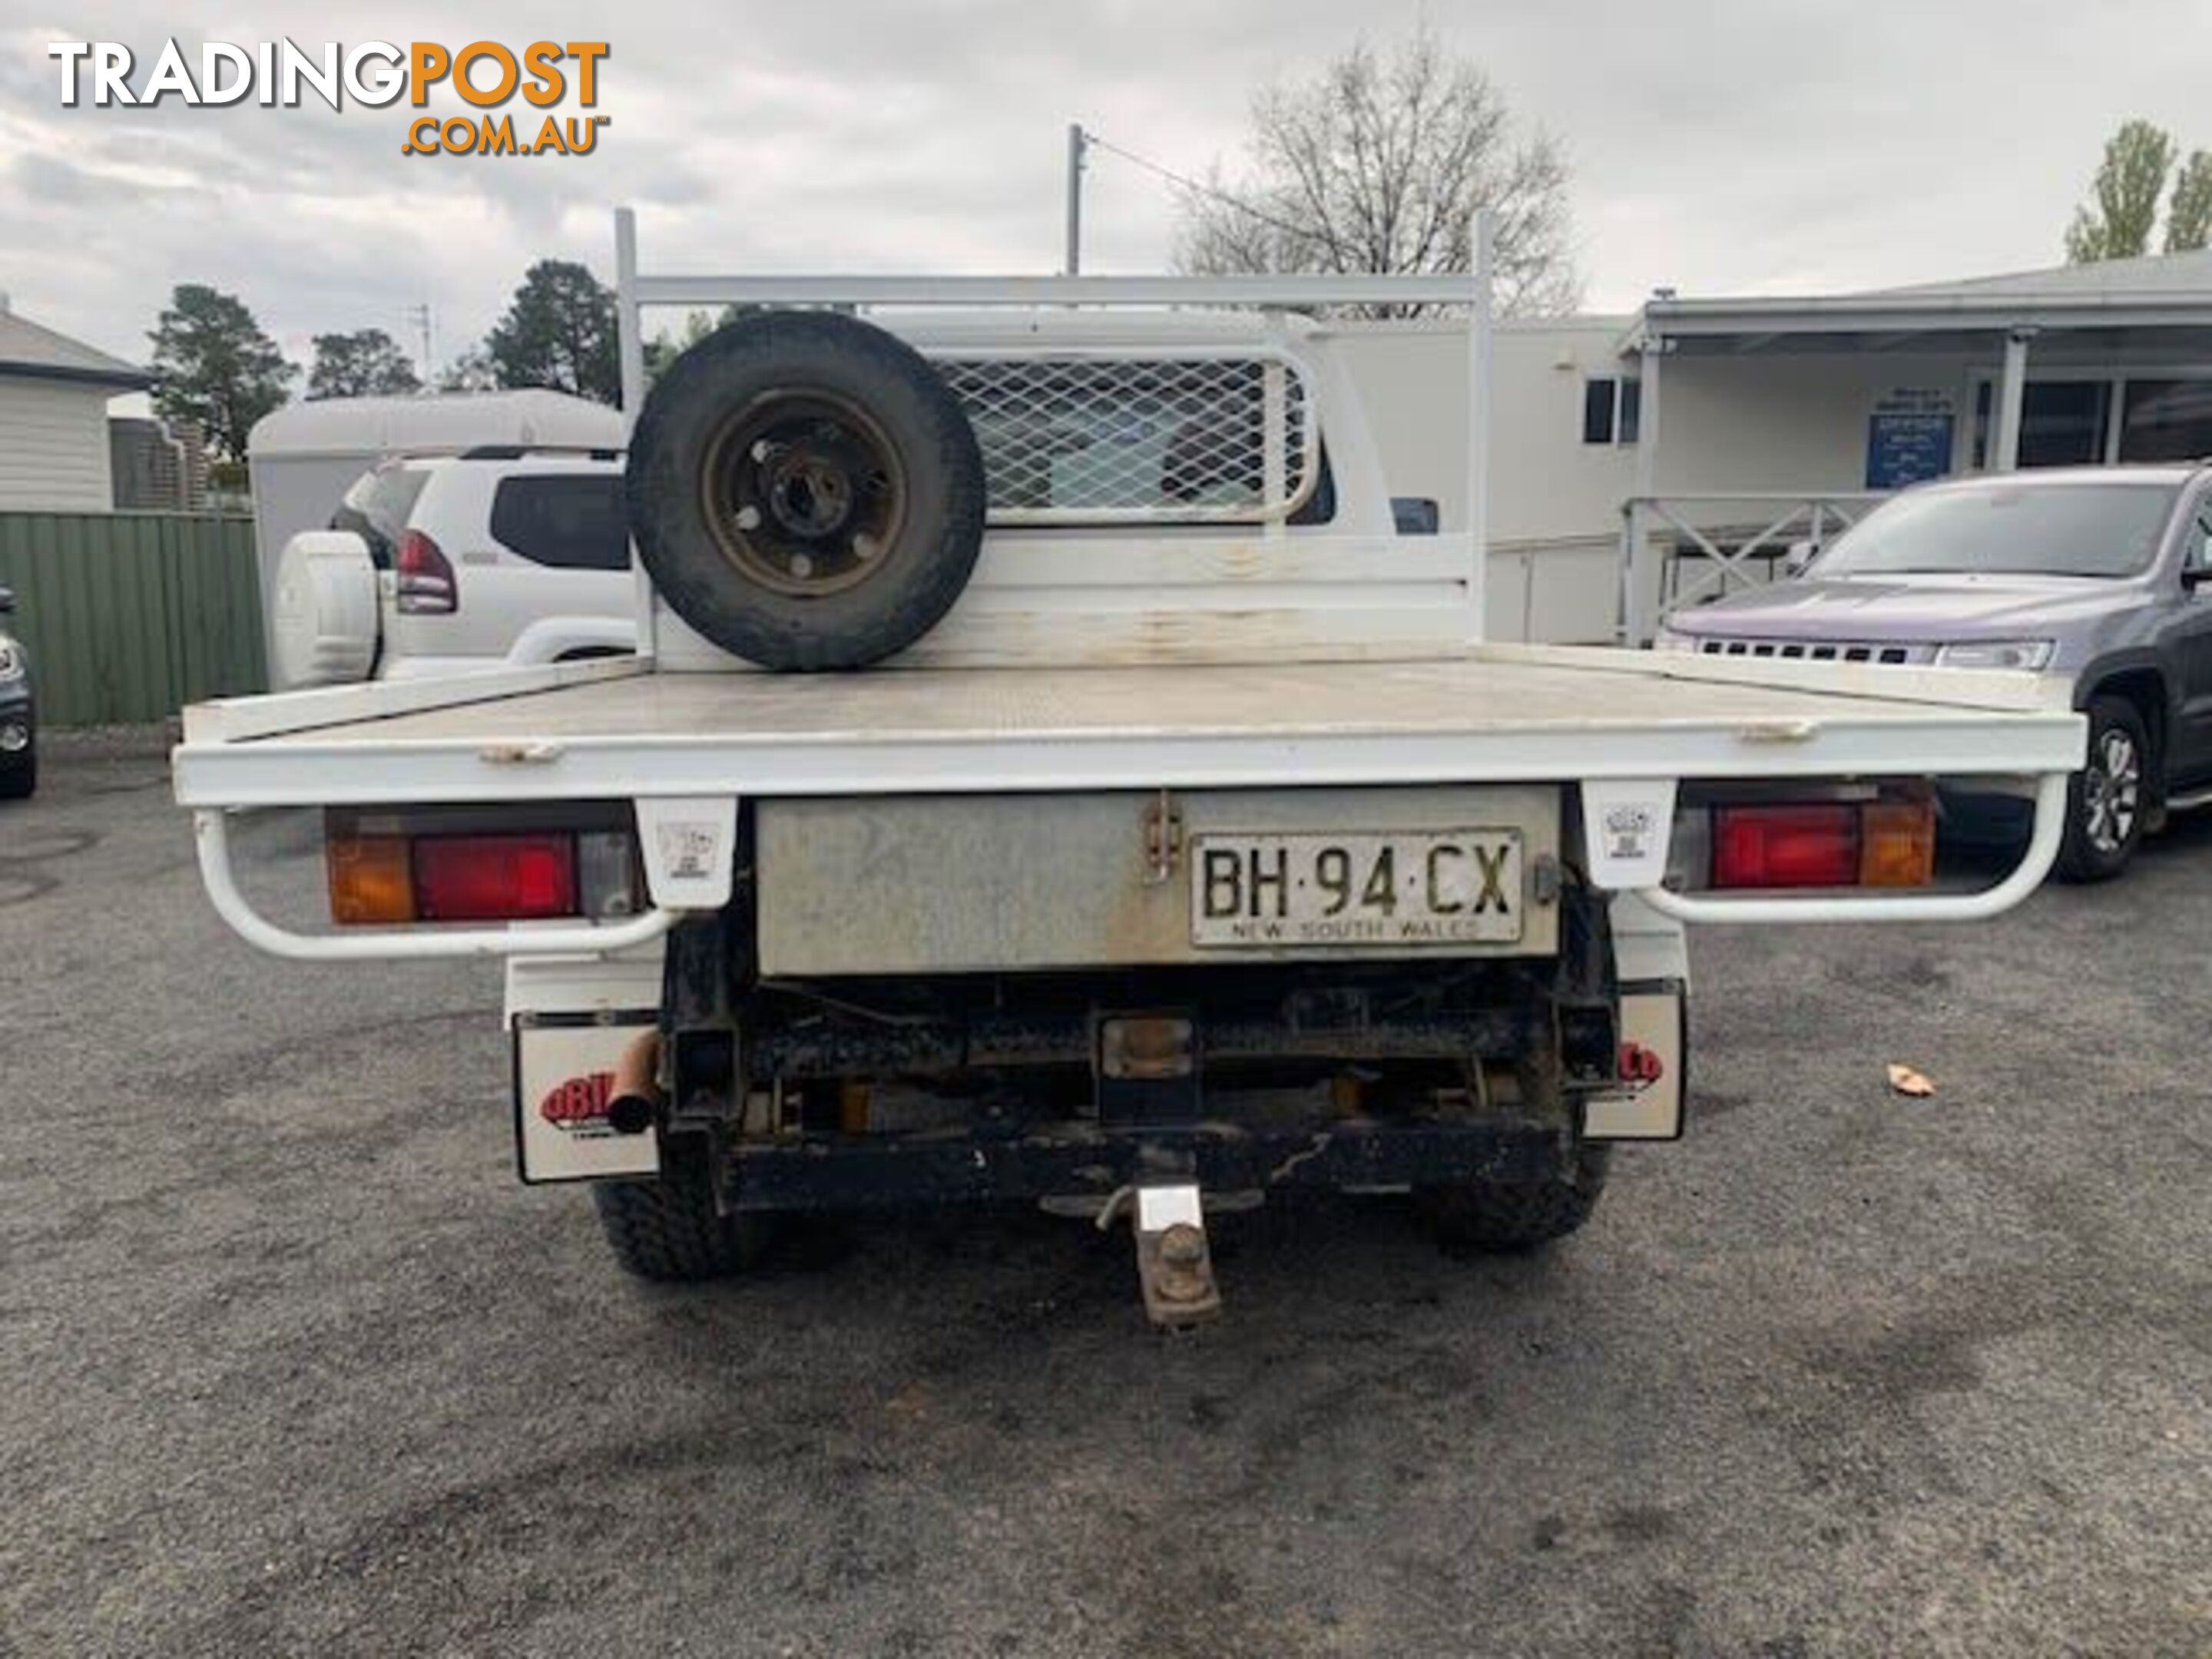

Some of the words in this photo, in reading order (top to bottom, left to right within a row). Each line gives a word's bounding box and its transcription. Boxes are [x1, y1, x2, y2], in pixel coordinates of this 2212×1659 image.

[1232, 922, 1281, 938] NEW
[1301, 922, 1382, 937] SOUTH
[1400, 921, 1477, 936] WALES
